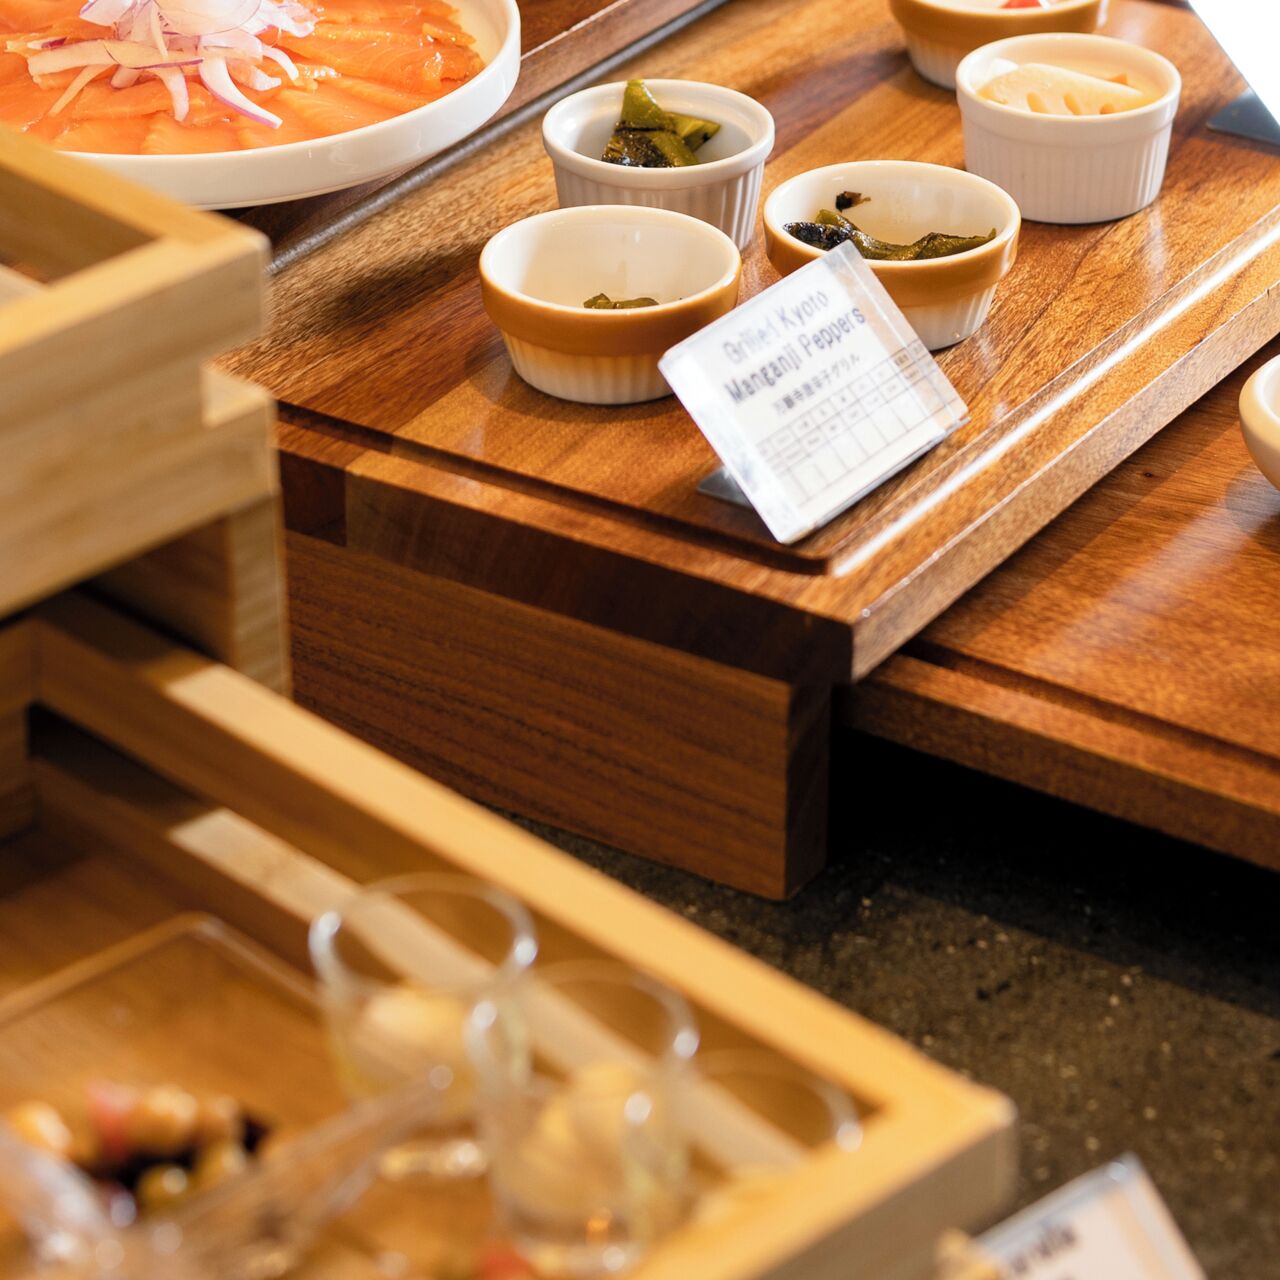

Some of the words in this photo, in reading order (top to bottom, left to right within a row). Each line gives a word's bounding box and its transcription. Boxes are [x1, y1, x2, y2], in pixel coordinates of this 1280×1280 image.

[776, 290, 830, 332] Kyoto
[724, 342, 803, 406] Manganji
[798, 307, 866, 358] Peppers
